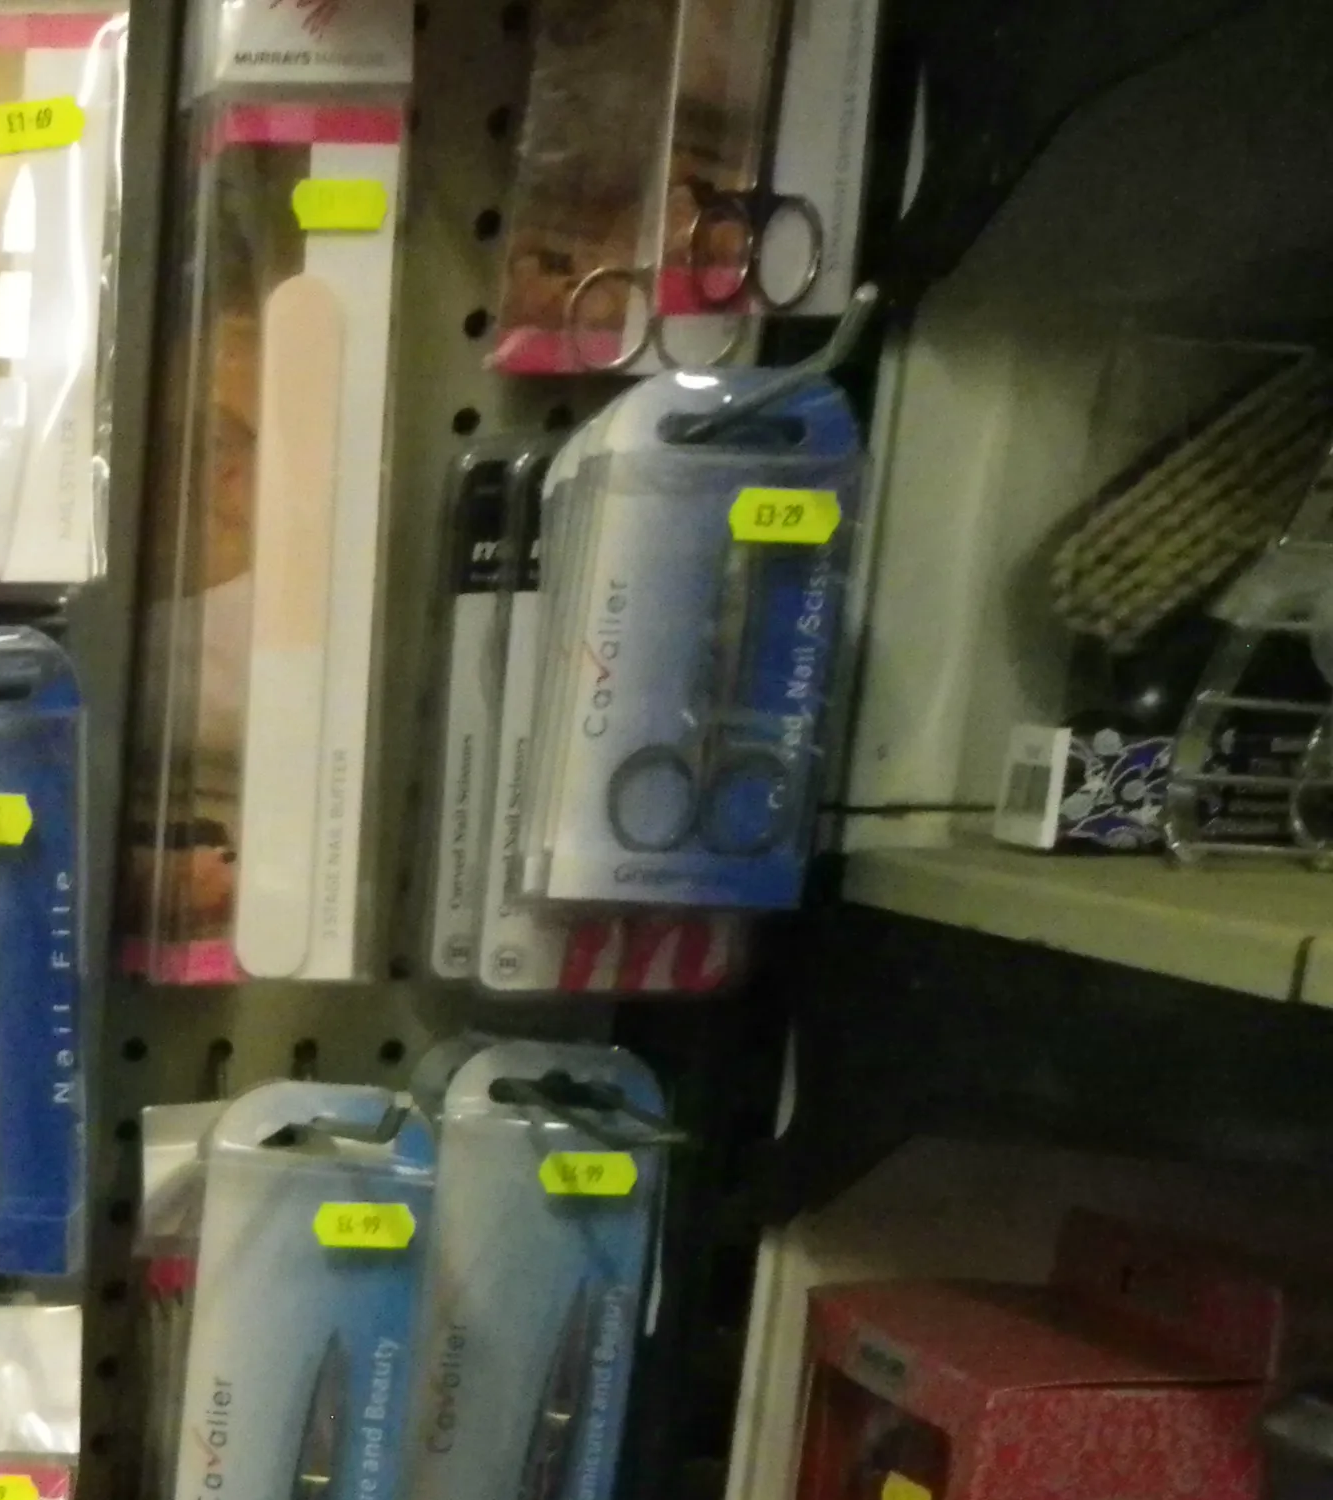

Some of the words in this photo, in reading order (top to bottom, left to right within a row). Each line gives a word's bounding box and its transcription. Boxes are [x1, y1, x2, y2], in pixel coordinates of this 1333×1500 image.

[51, 870, 73, 970] File
[51, 1002, 73, 1103] Nail
[364, 1336, 400, 1421] Beauty
[359, 1425, 385, 1473] and
